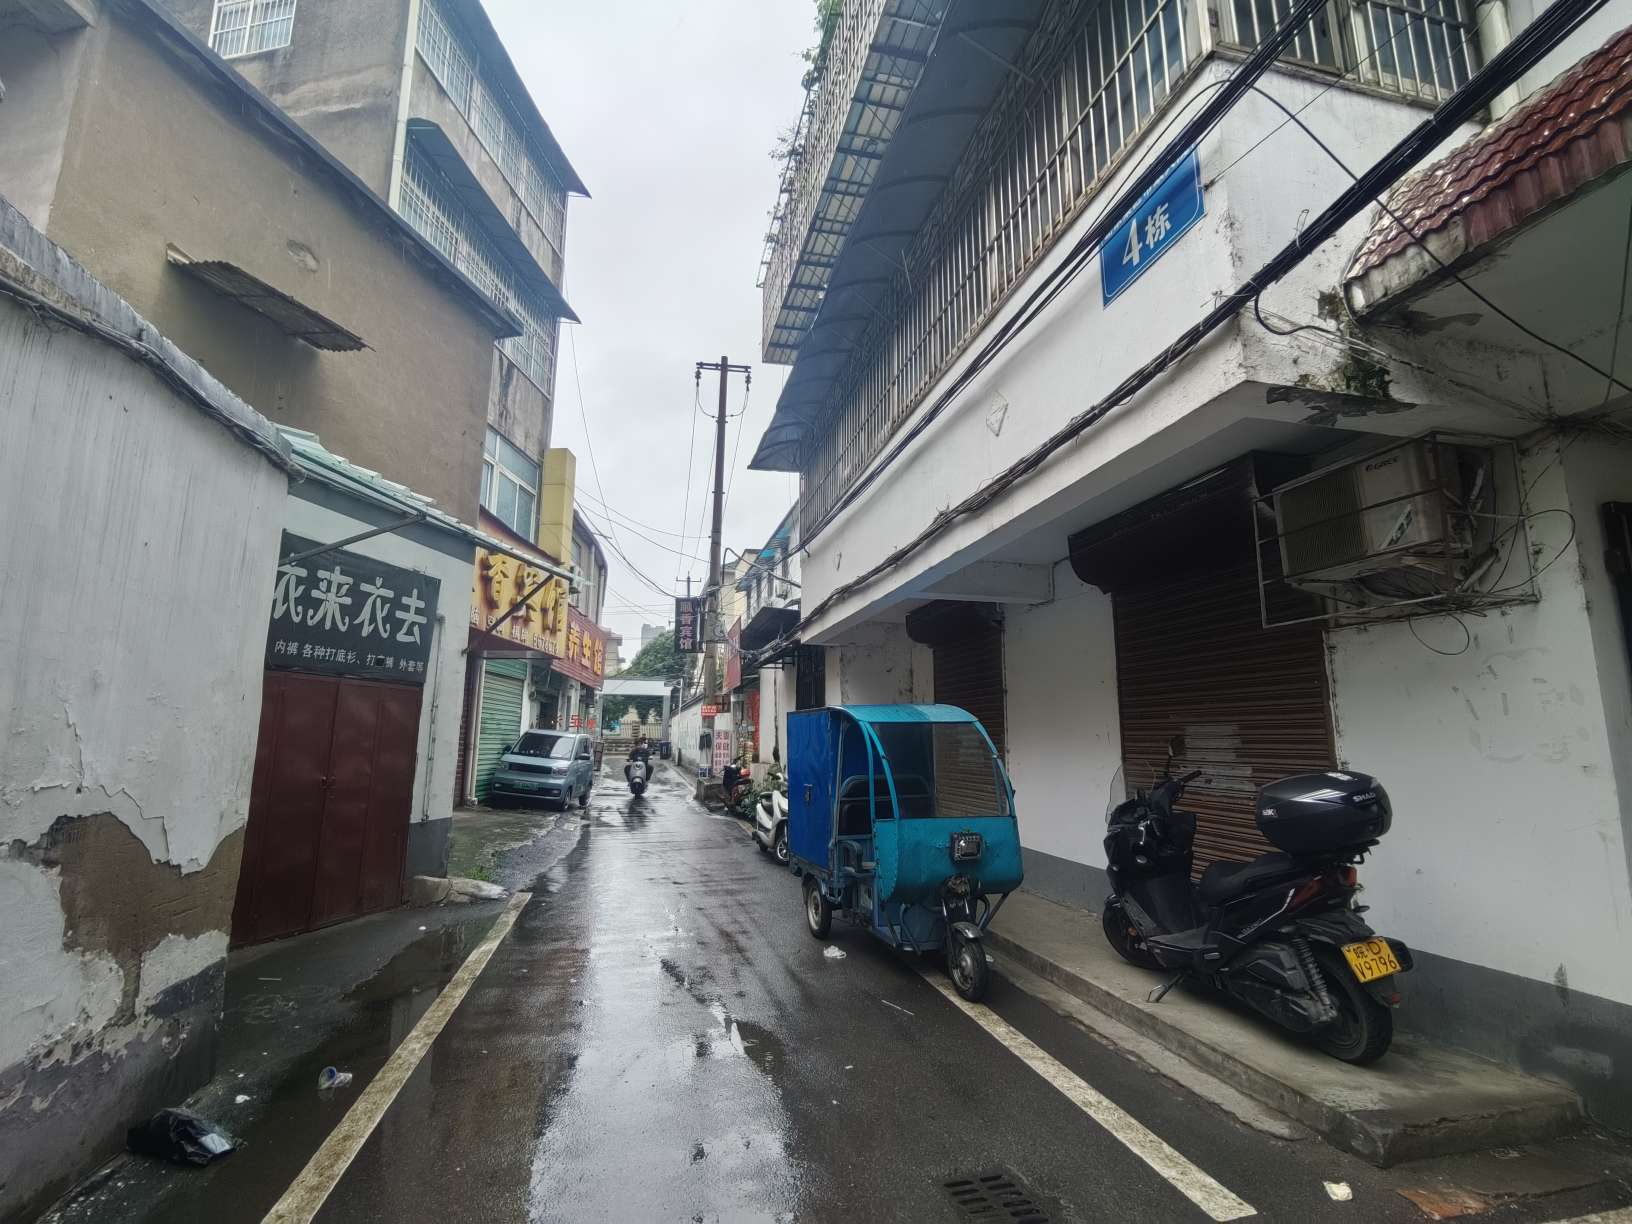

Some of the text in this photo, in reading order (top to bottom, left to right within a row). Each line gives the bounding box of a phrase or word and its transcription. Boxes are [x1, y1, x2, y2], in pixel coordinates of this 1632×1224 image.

[1122, 202, 1172, 267] 4栋
[272, 556, 428, 646] 衣来衣去
[1355, 954, 1397, 979] V9796
